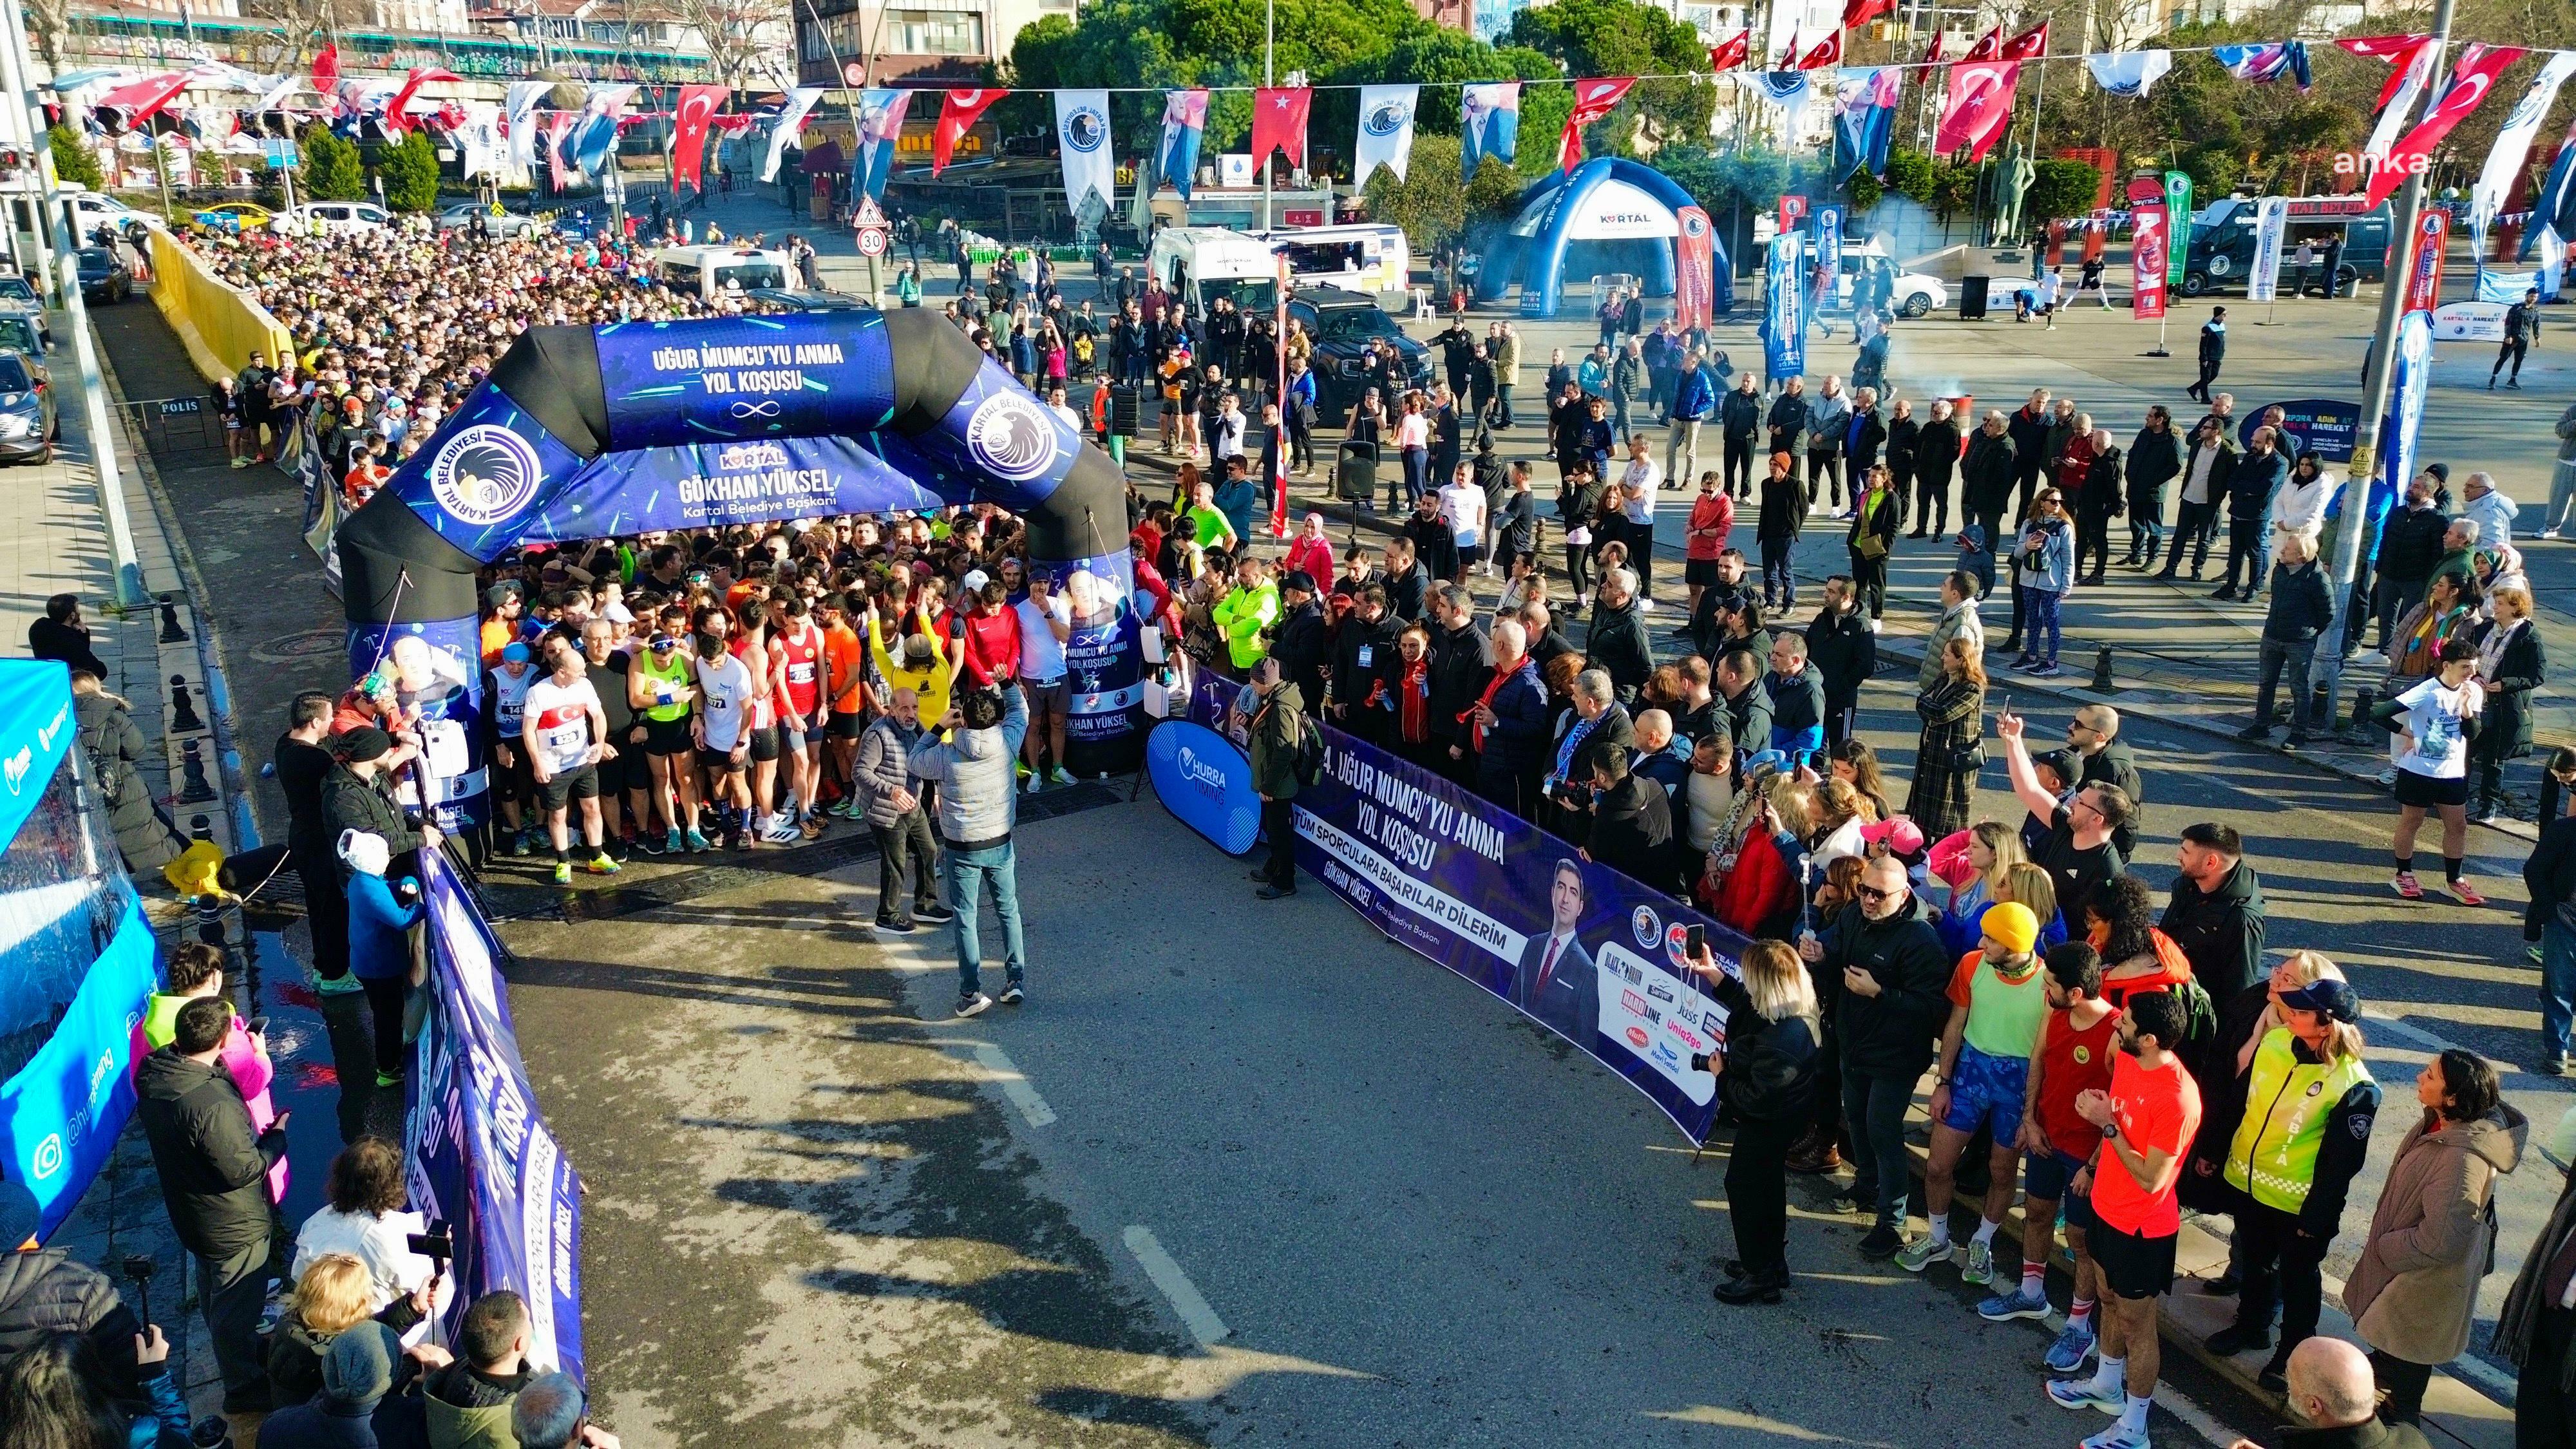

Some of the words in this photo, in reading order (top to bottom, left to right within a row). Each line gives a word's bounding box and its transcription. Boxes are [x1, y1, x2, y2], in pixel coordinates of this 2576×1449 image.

[864, 235, 880, 247] 30
[652, 346, 699, 371] UĞUR
[795, 344, 844, 365] ANMA
[702, 372, 736, 394] YOL
[737, 370, 802, 395] KOŞUSU
[162, 400, 198, 412] POLİS
[971, 404, 999, 440] KARTAL
[2311, 422, 2351, 432] HAREKET
[438, 429, 482, 485] BELEDİYESİ
[679, 474, 759, 504] GÖKHAN
[761, 468, 835, 496] YÜKSEL
[442, 487, 487, 520] KARTAL
[683, 504, 724, 518] Kartal
[729, 500, 782, 515] Belediye
[786, 497, 837, 510] Başkanı
[1110, 641, 1128, 654] ANMA
[1083, 656, 1112, 670] KOŞUSU
[1095, 713, 1128, 728] YÜKSEL
[1193, 759, 1226, 788] HURRA
[1193, 777, 1224, 805] TIMING
[1338, 750, 1374, 797] UĞUR
[1454, 811, 1504, 866] ANMA
[1357, 799, 1378, 841] YOL
[1380, 814, 1437, 871] KOŞUSU
[1294, 811, 1315, 835] TÜM
[1316, 826, 1379, 878] SPORCULARA
[1379, 867, 1446, 917] BAŞARILAR
[1446, 906, 1507, 951] DİLERİM
[1323, 861, 1349, 891] GÖKHAN
[1349, 877, 1372, 907] YÜKSEL
[1388, 910, 1413, 932] Belediye
[1414, 925, 1441, 945] Başkanı
[1651, 1050, 1665, 1063] Mavi
[1664, 1057, 1680, 1075] Sandal
